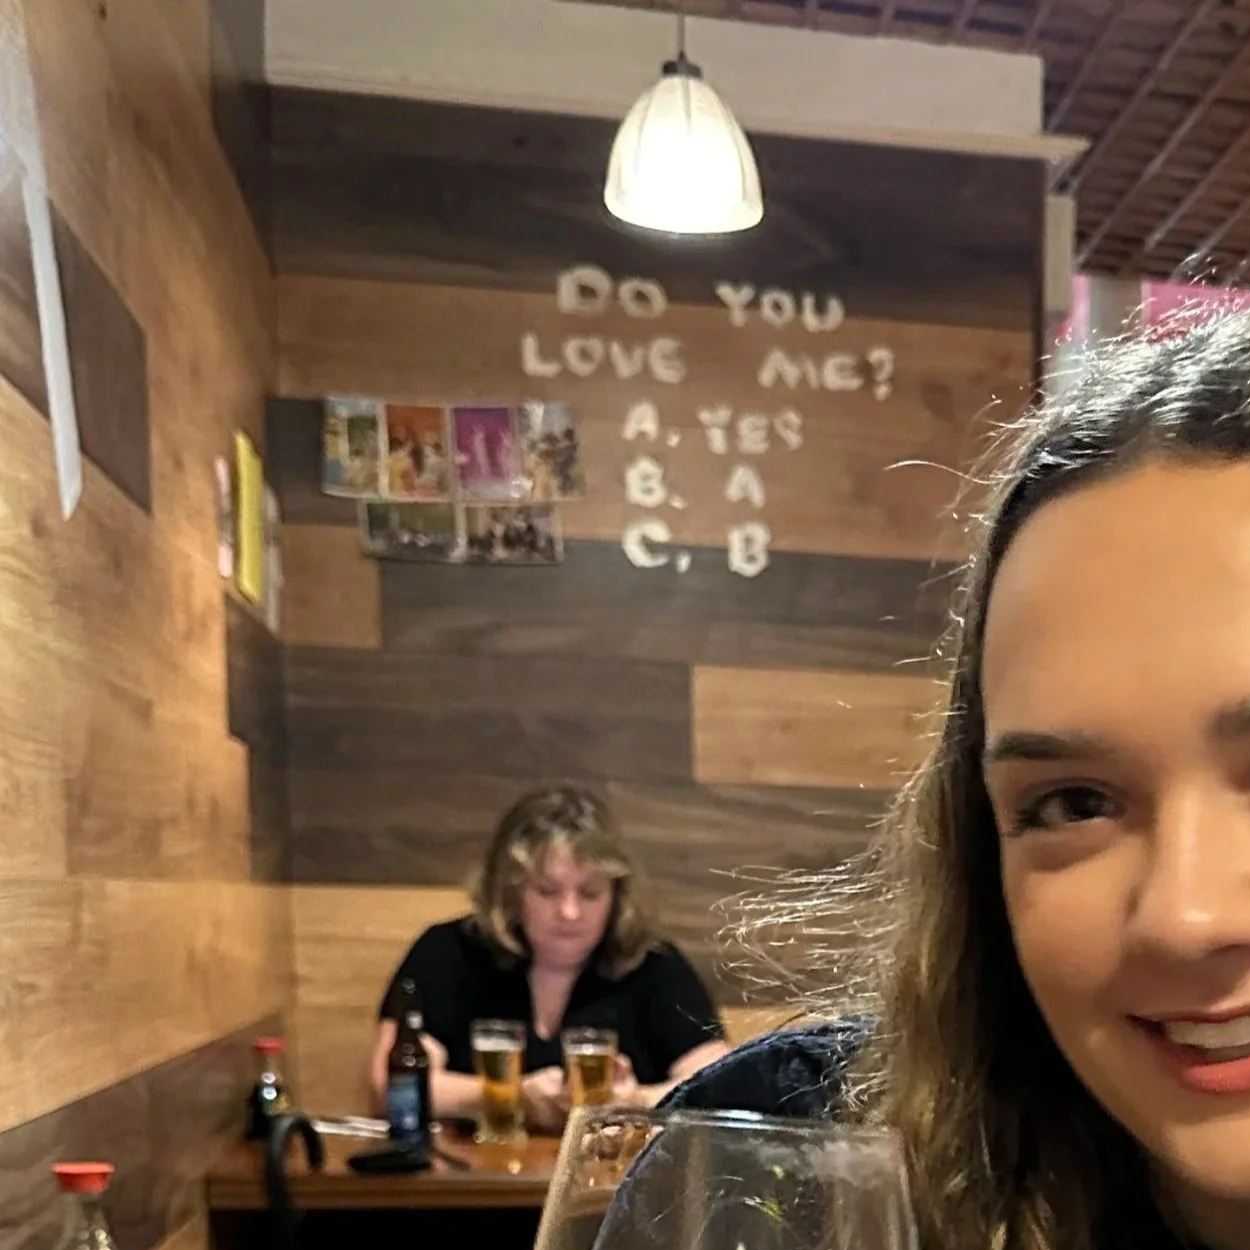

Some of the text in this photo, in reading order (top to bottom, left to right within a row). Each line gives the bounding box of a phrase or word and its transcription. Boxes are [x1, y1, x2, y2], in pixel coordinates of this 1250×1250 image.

[556, 264, 846, 333] DO YOU
[520, 331, 895, 401] LOVE ME?
[697, 404, 804, 455] YES
[725, 464, 766, 508] A
[727, 520, 771, 577] B
